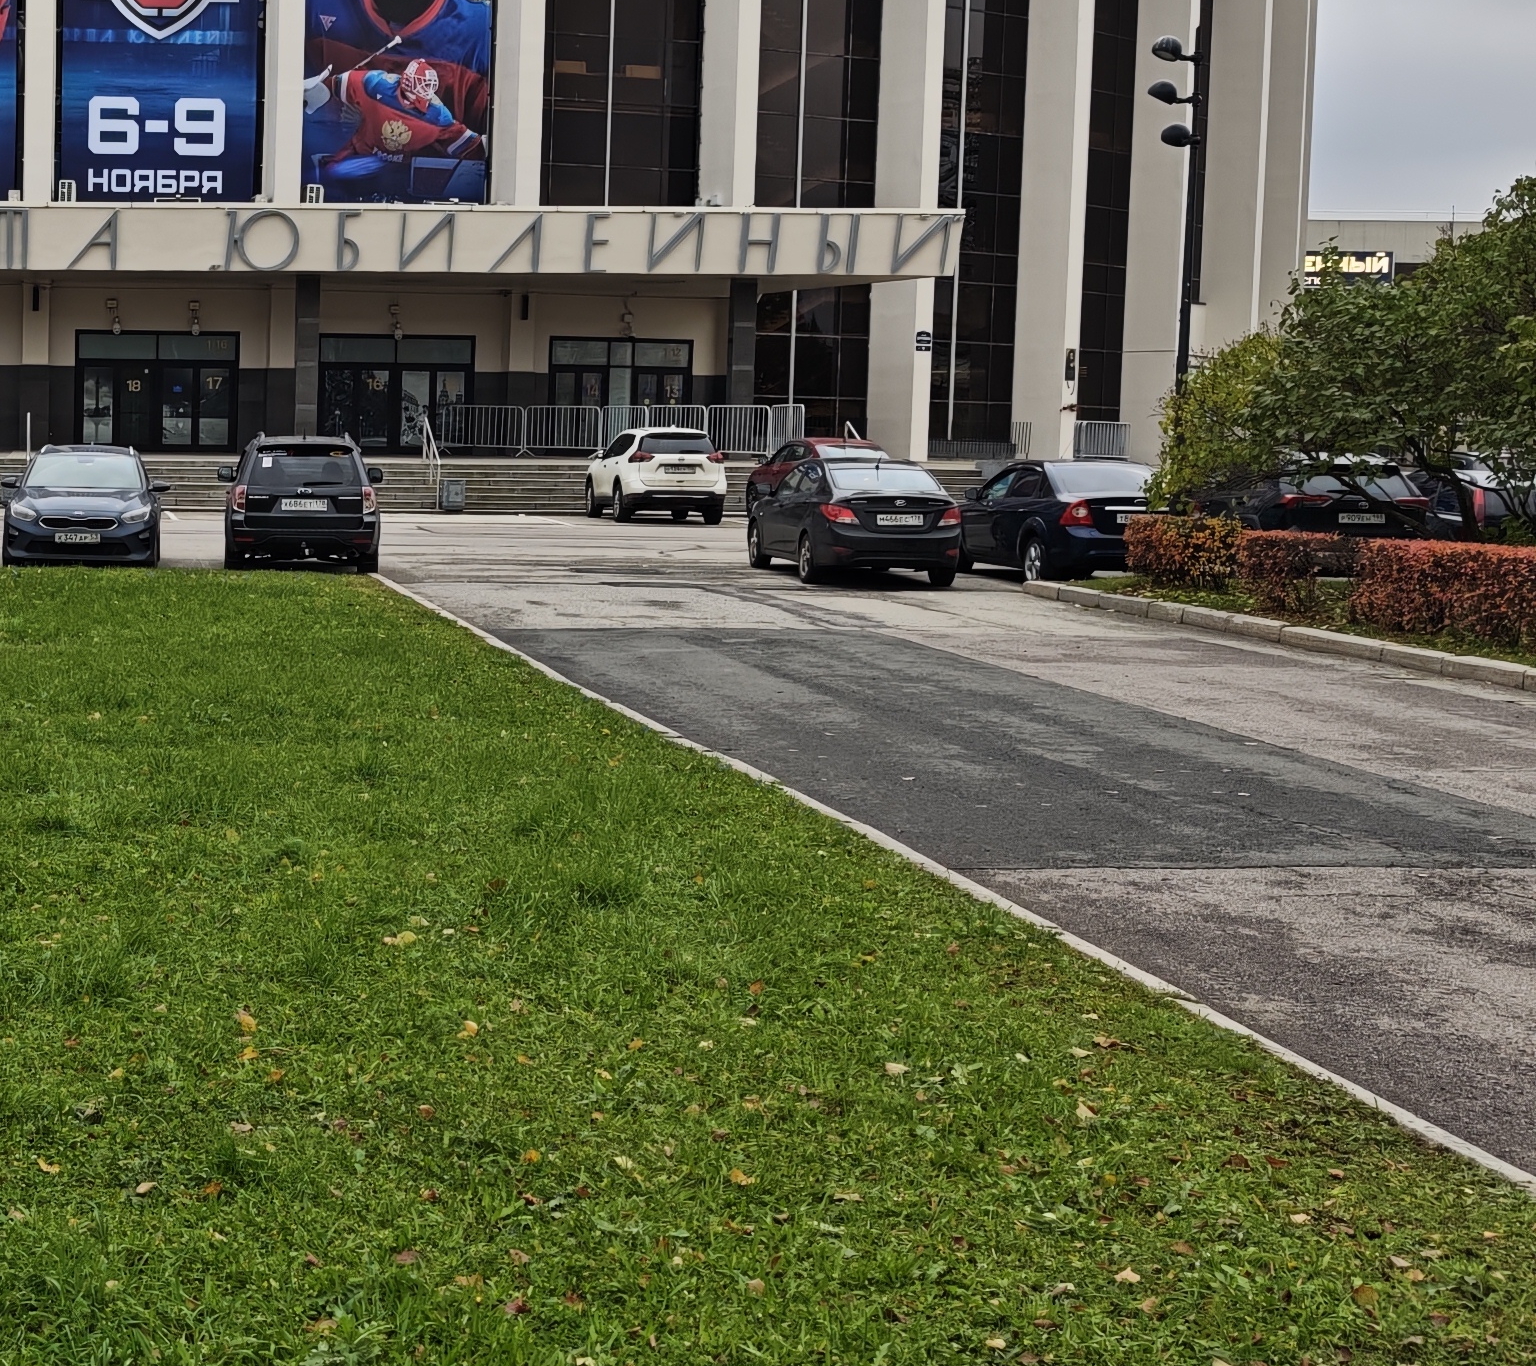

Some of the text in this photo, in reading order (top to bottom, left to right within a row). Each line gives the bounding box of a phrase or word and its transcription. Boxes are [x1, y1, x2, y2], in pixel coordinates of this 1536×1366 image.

[88, 96, 226, 157] 6-9
[87, 168, 223, 194] НОЯБРЯ
[126, 379, 141, 392] 18
[206, 376, 223, 390] 17
[366, 378, 384, 391] 16
[586, 385, 599, 396] 14
[665, 386, 679, 398] 13
